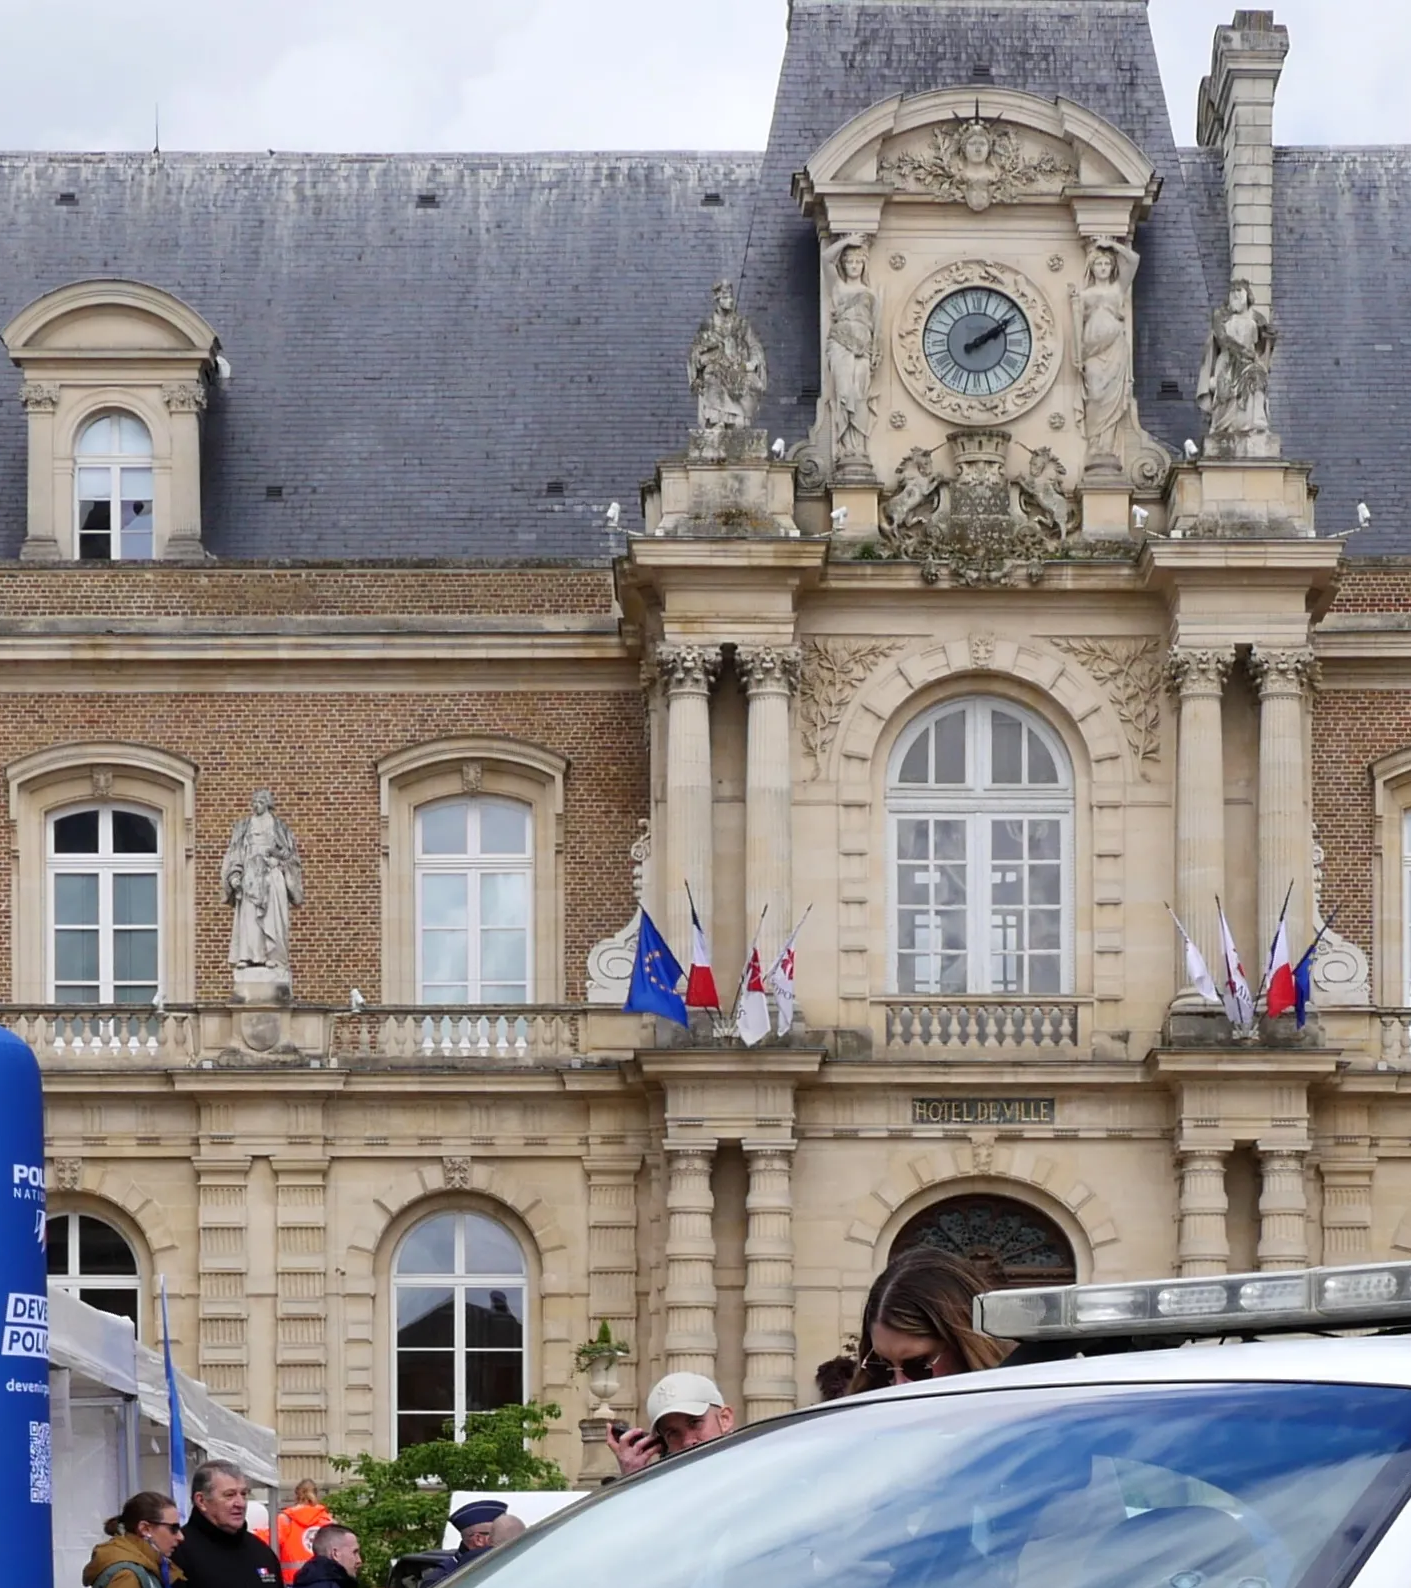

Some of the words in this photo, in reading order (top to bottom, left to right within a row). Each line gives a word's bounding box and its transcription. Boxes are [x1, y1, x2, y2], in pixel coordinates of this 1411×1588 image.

[914, 1101, 973, 1121] HOTEL
[978, 1101, 999, 1121] DE
[1002, 1101, 1050, 1121] VILLE
